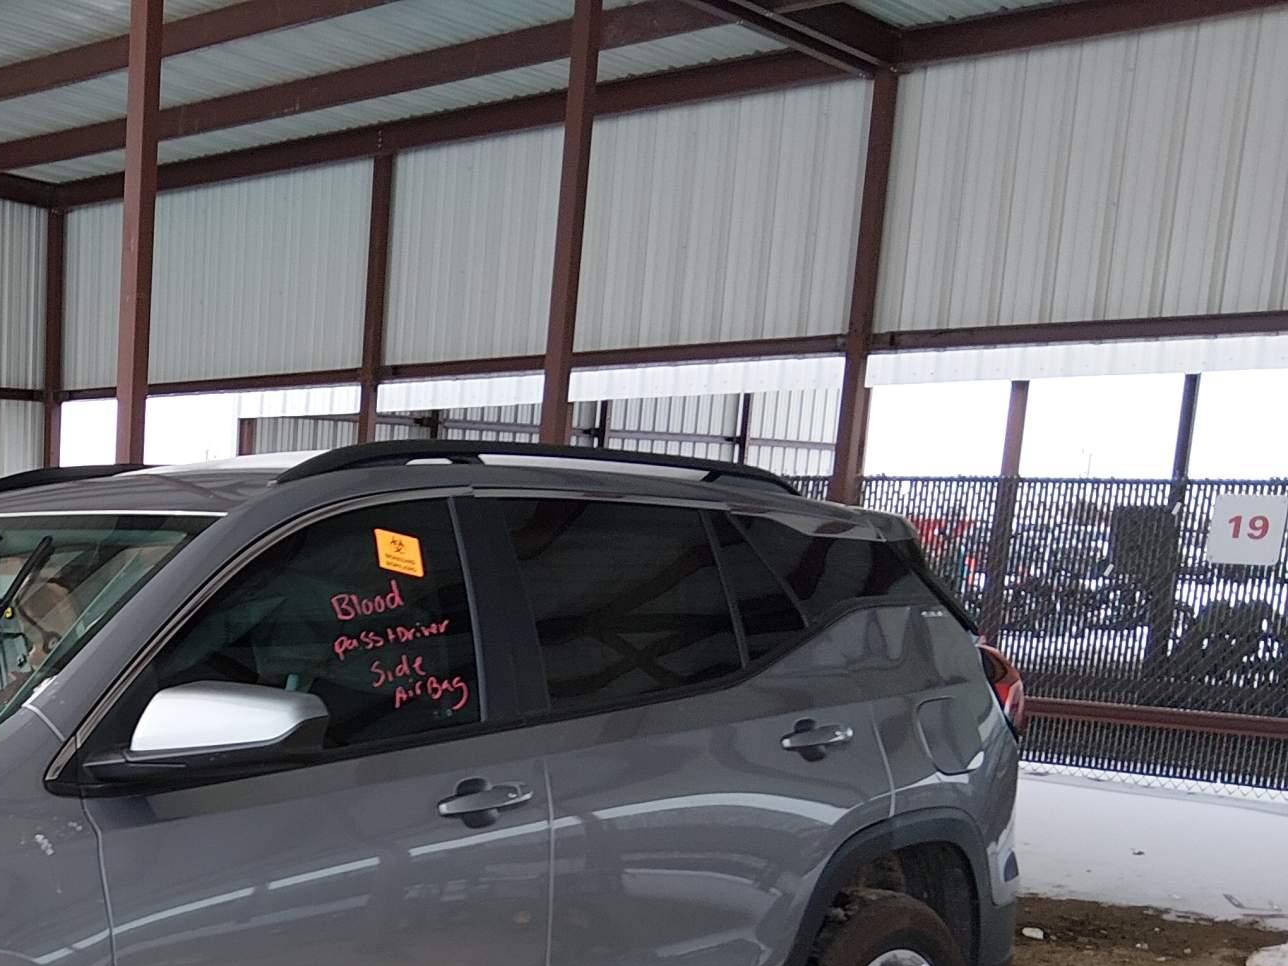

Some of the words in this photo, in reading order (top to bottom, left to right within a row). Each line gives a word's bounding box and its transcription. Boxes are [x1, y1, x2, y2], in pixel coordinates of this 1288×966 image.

[1228, 515, 1270, 540] 19
[331, 579, 404, 621] Blood
[370, 654, 427, 688] Side
